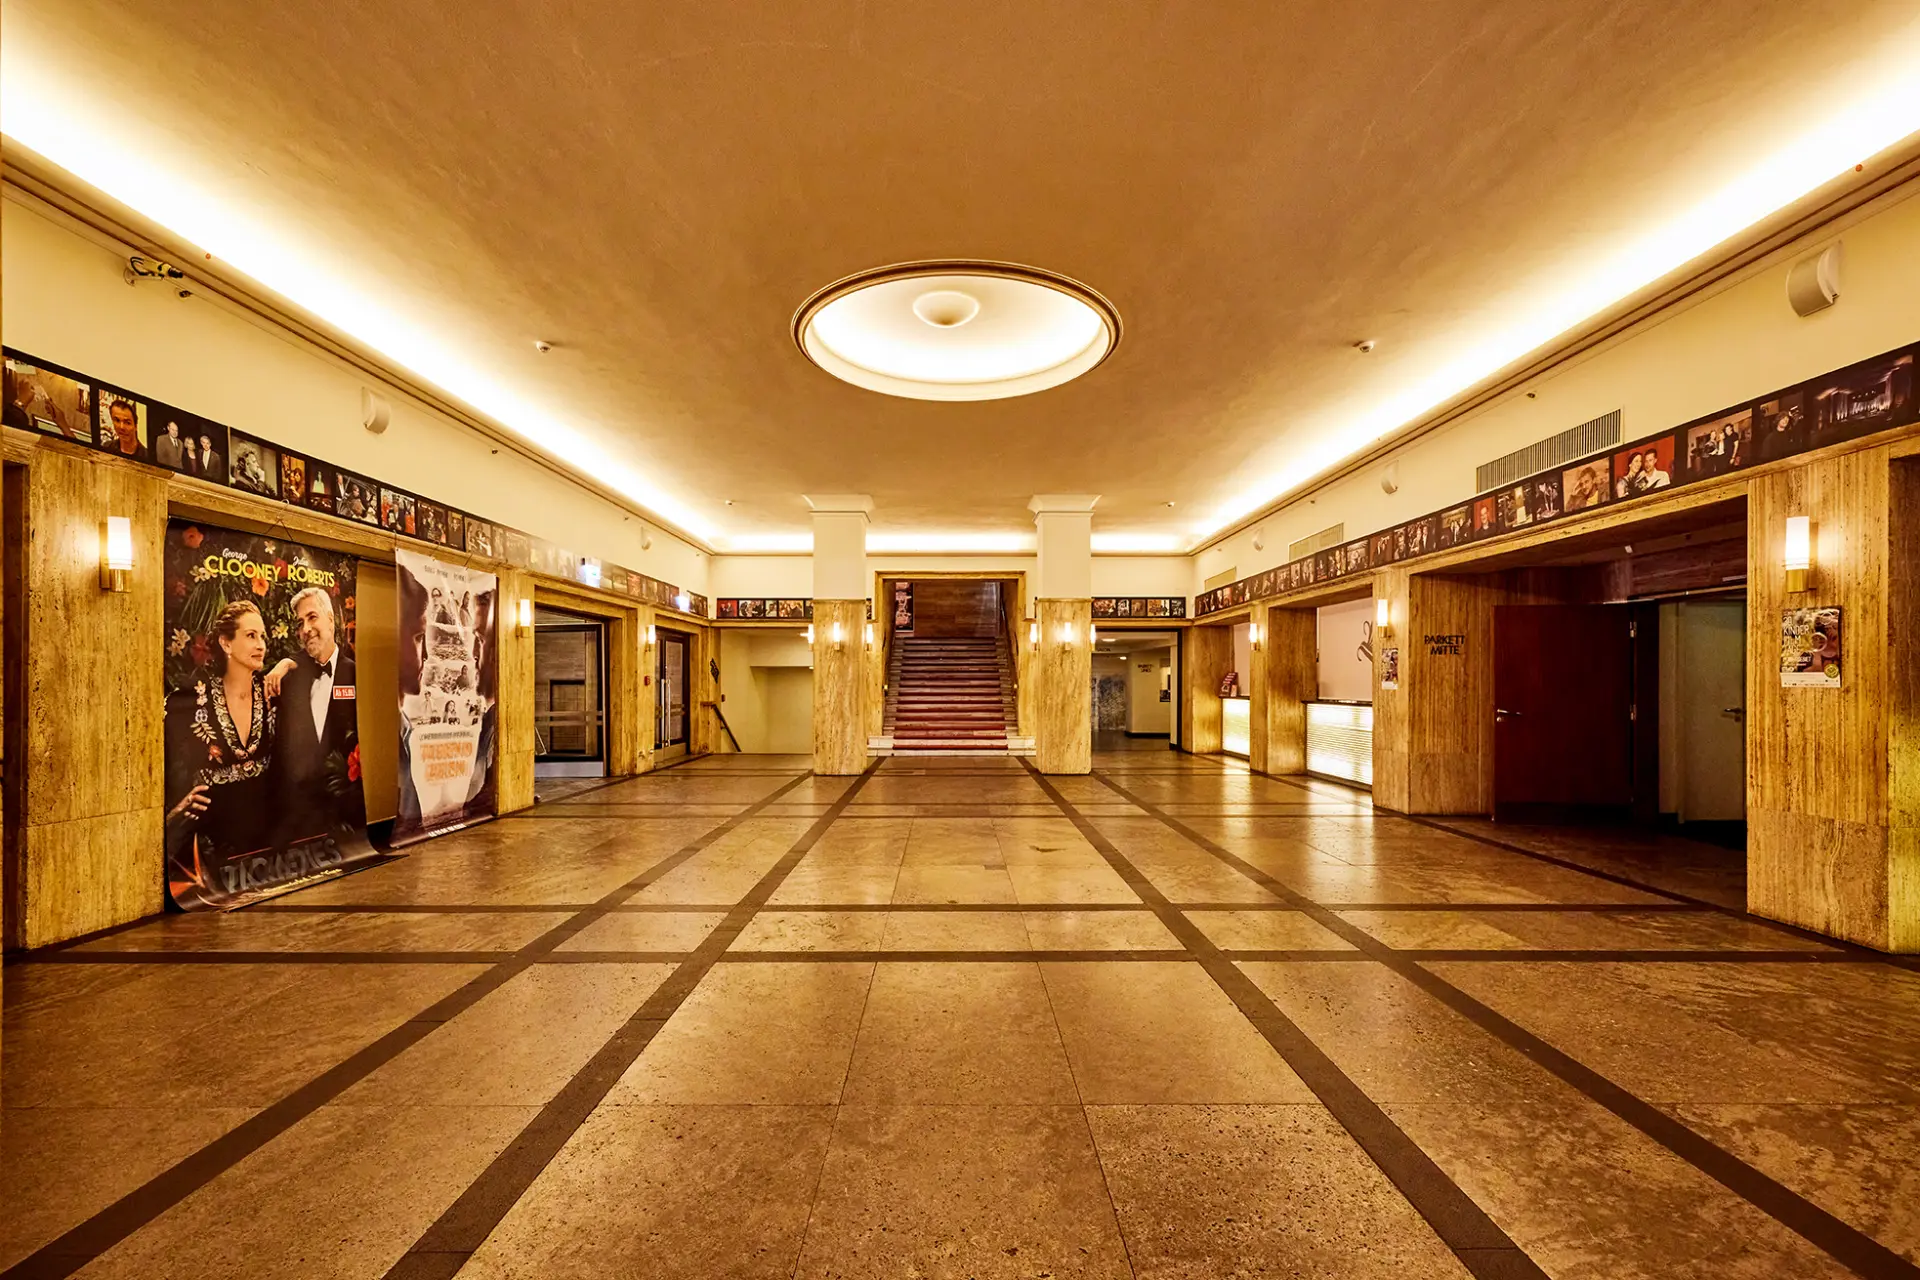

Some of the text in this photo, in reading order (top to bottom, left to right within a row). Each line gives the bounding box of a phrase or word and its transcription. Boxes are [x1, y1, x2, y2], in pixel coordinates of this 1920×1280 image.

[222, 548, 248, 561] George
[204, 555, 335, 588] CLOONEY ROBERTS
[1783, 625, 1809, 635] KINDER
[1424, 635, 1465, 645] PARKETT
